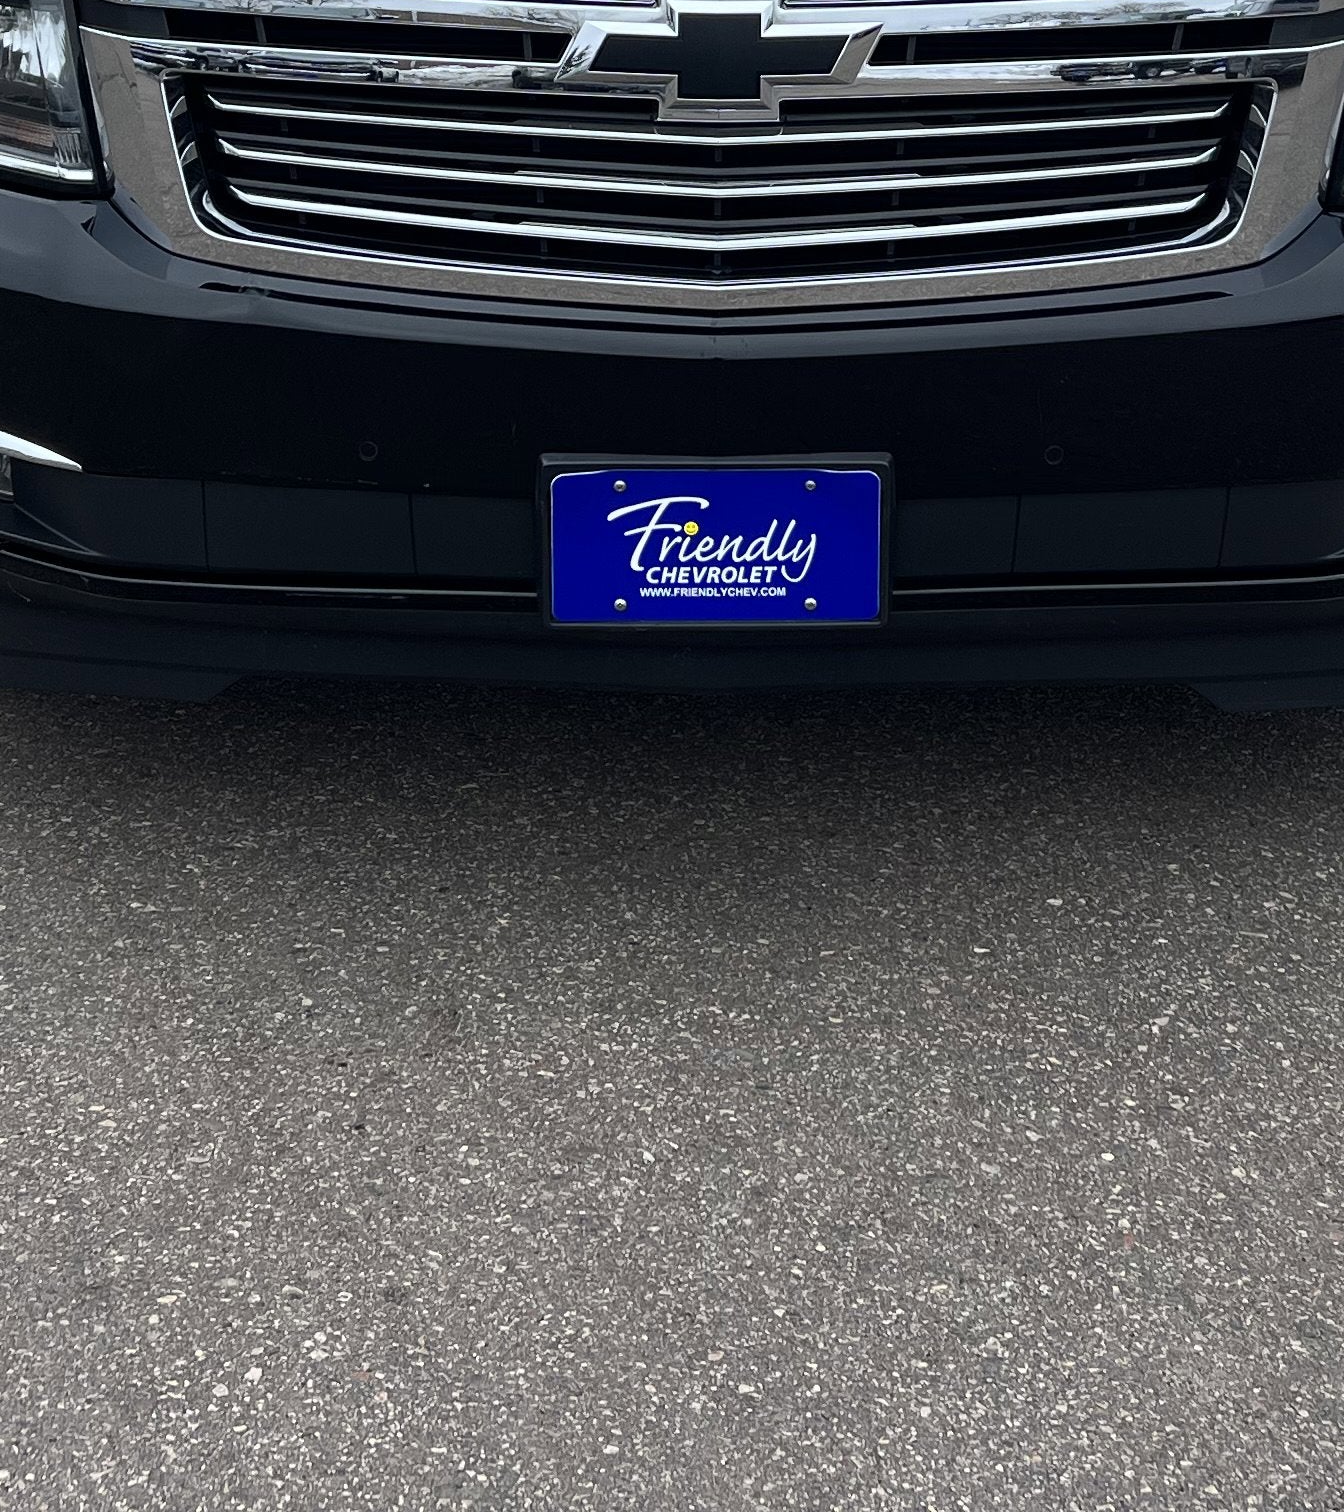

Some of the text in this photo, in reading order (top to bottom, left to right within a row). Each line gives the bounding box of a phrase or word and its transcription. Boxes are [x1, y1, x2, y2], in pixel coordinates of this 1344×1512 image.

[606, 496, 817, 583] Friendly
[645, 565, 778, 584] CHEVROLET
[639, 586, 787, 597] WWW.FRIENDLYCHEV.COM
